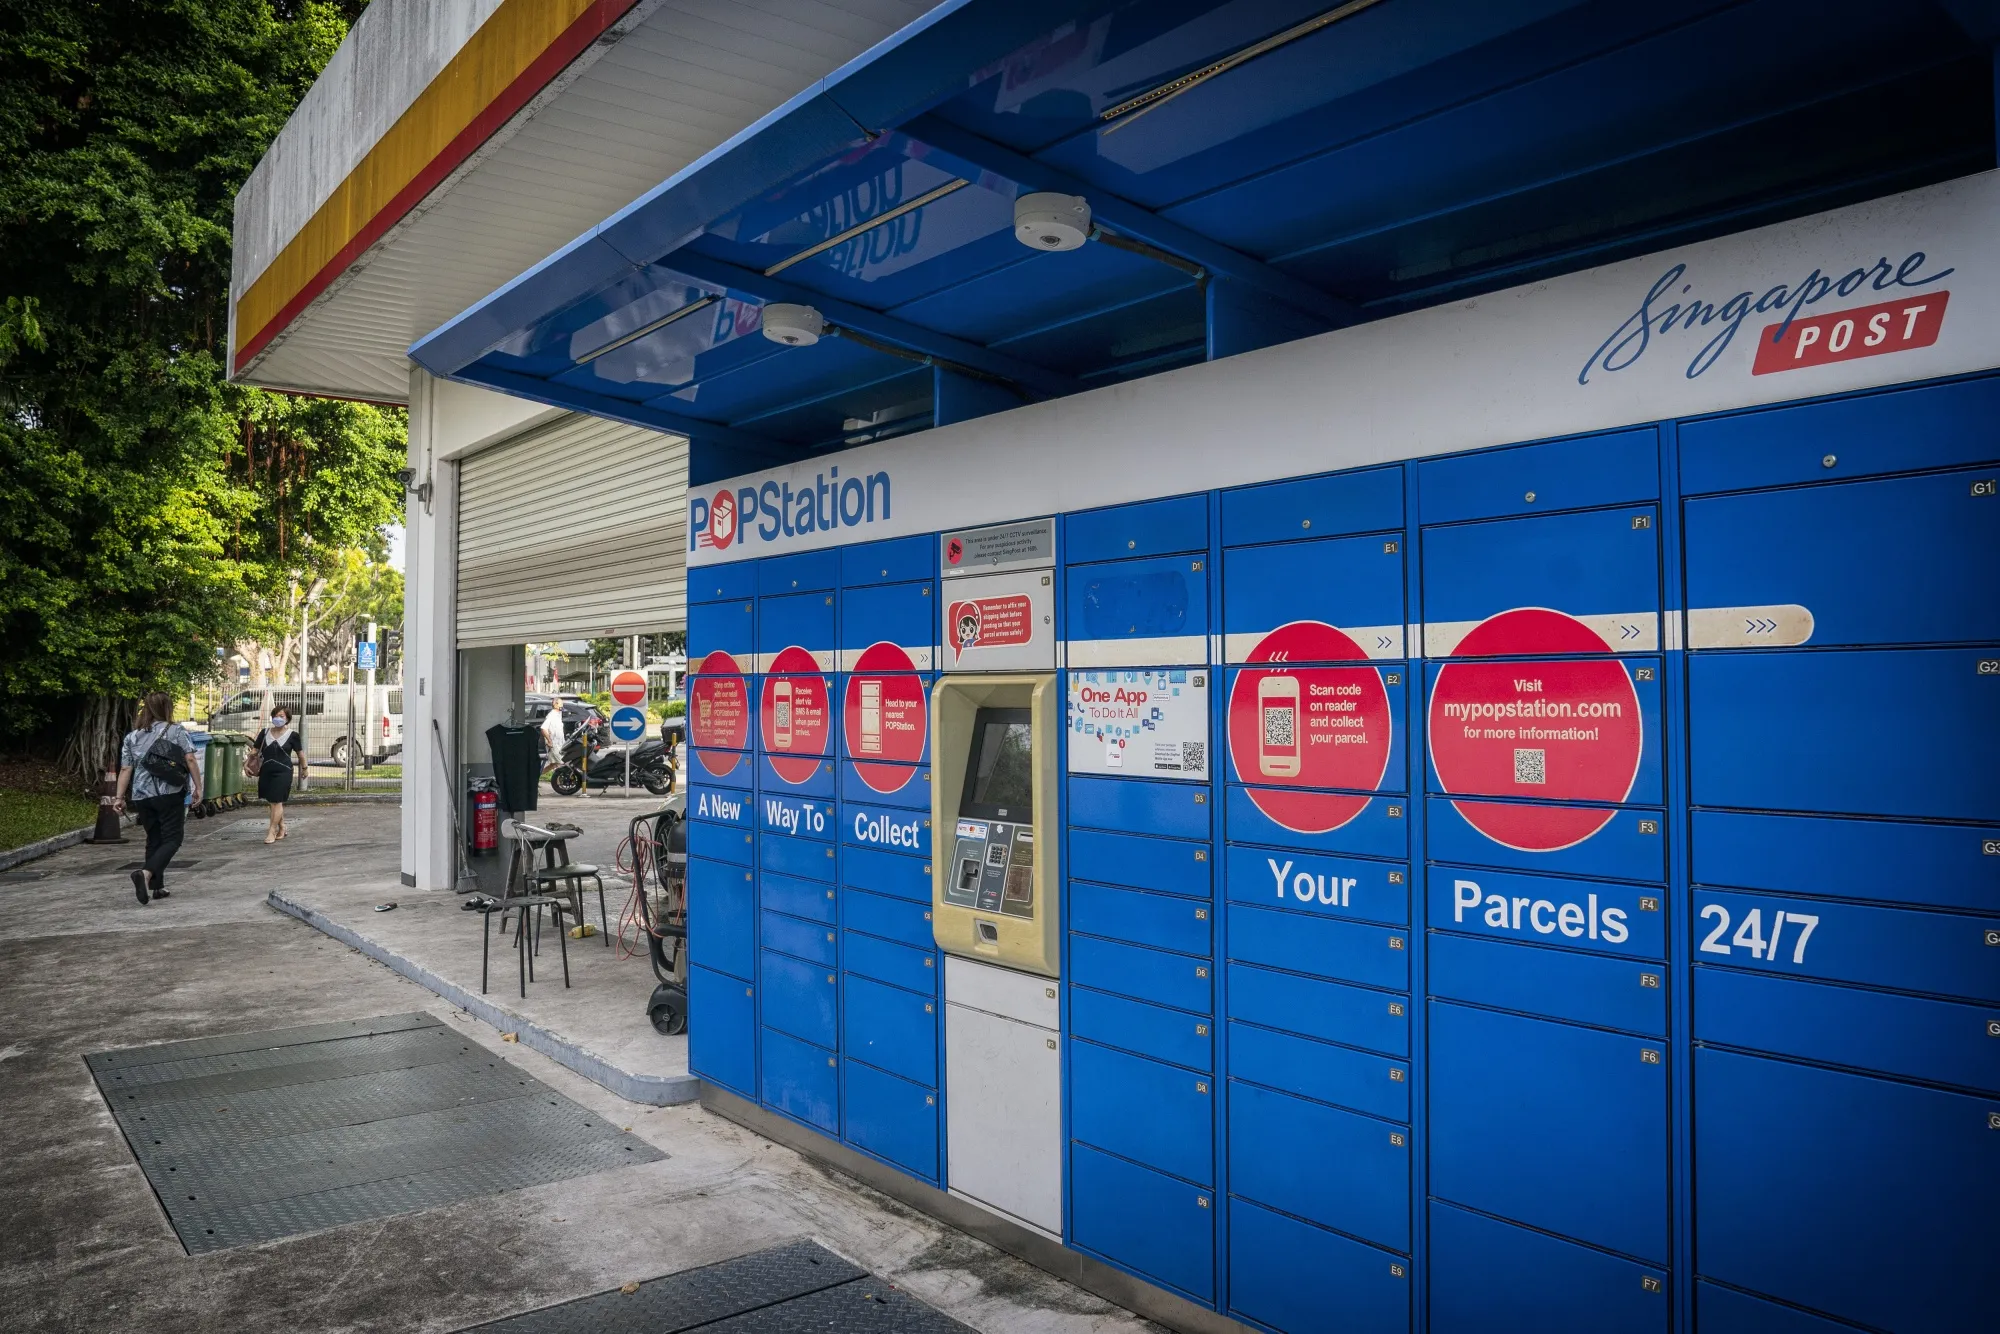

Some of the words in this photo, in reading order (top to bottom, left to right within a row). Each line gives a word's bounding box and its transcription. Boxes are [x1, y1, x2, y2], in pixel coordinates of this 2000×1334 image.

[1578, 252, 1954, 385] Singapore
[1794, 305, 1926, 358] POST
[1974, 482, 1992, 495] G1
[690, 466, 891, 551] POPStation
[1635, 517, 1647, 528] F1
[983, 613, 999, 621] shipping
[983, 622, 997, 630] posting
[983, 631, 995, 639] parcel
[1979, 661, 1998, 673] G2
[1387, 675, 1398, 684] E2
[1638, 669, 1650, 680] F2
[795, 687, 812, 695] Receive
[1309, 684, 1334, 696] Scan
[1336, 684, 1361, 696] code
[1514, 679, 1542, 692] Visit
[795, 698, 804, 706] alert
[1081, 687, 1110, 703] One
[1114, 687, 1148, 706] App
[885, 699, 898, 708] Head
[899, 699, 905, 708] to
[905, 700, 917, 709] your
[1310, 702, 1323, 711] on
[1324, 700, 1357, 711] reader
[810, 708, 821, 716] email
[885, 711, 904, 719] nearest
[1089, 707, 1100, 719] To
[1102, 707, 1116, 719] Do
[1117, 707, 1124, 719] It
[1125, 707, 1139, 719] All
[1444, 698, 1621, 722] mypopstation.com
[795, 718, 807, 726] when
[807, 719, 820, 727] parcel
[885, 721, 916, 731] POPStation.
[1310, 716, 1328, 727] and
[1330, 716, 1364, 728] collect
[1310, 733, 1333, 745] your
[1335, 732, 1368, 746] parcel.
[1463, 726, 1481, 739] for
[1484, 729, 1516, 739] more
[1519, 727, 1599, 741] information!
[1641, 822, 1653, 832] F3
[698, 792, 708, 817] A
[712, 794, 741, 821] New
[766, 800, 799, 835] Way
[803, 804, 824, 832] To
[854, 812, 919, 849] Collect
[1267, 858, 1357, 907] Your
[1454, 879, 1629, 944] Parcels
[1699, 903, 1819, 964] 24/7
[1641, 900, 1654, 910] F4
[1642, 976, 1656, 987] F5
[1988, 1022, 2000, 1034] G
[1643, 1051, 1656, 1062] F6
[1644, 1278, 1657, 1290] F7
